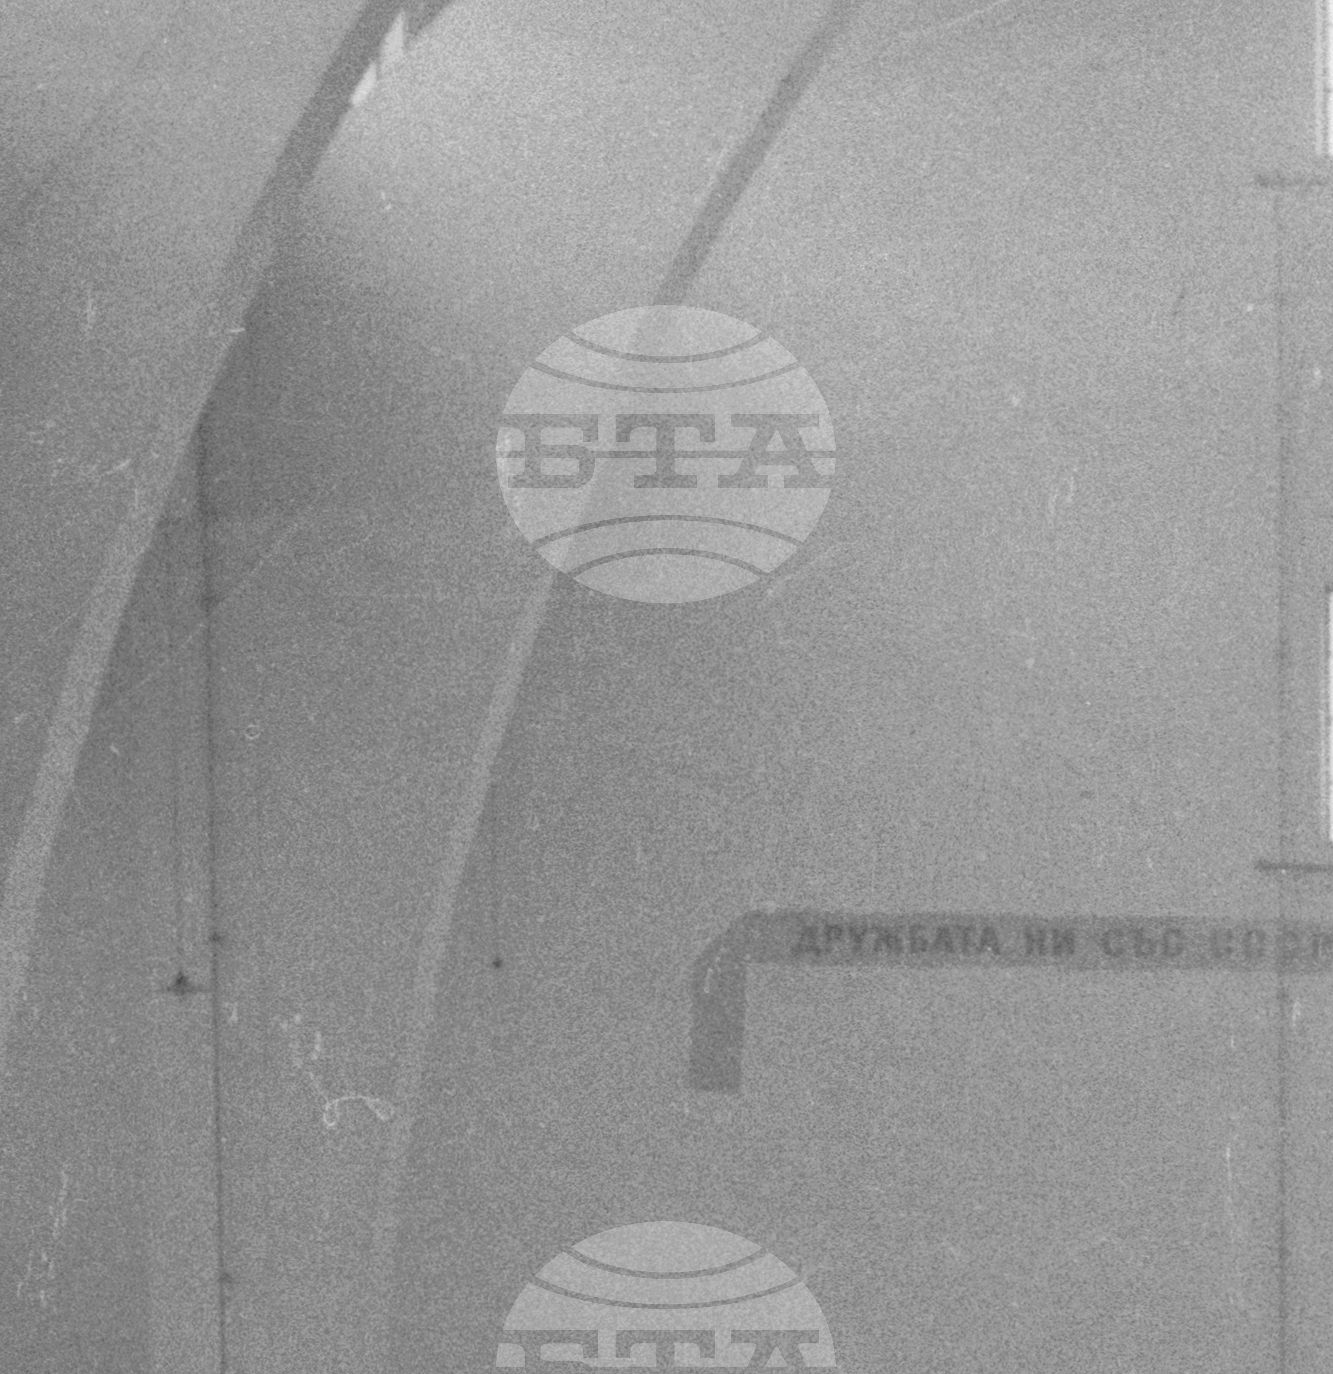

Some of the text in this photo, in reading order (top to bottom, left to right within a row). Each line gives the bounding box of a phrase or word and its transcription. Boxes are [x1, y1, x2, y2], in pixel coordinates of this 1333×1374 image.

[792, 923, 1002, 957] ДРУЖБАТА
[1024, 926, 1076, 957] НИ
[1100, 927, 1187, 960] СЪС
